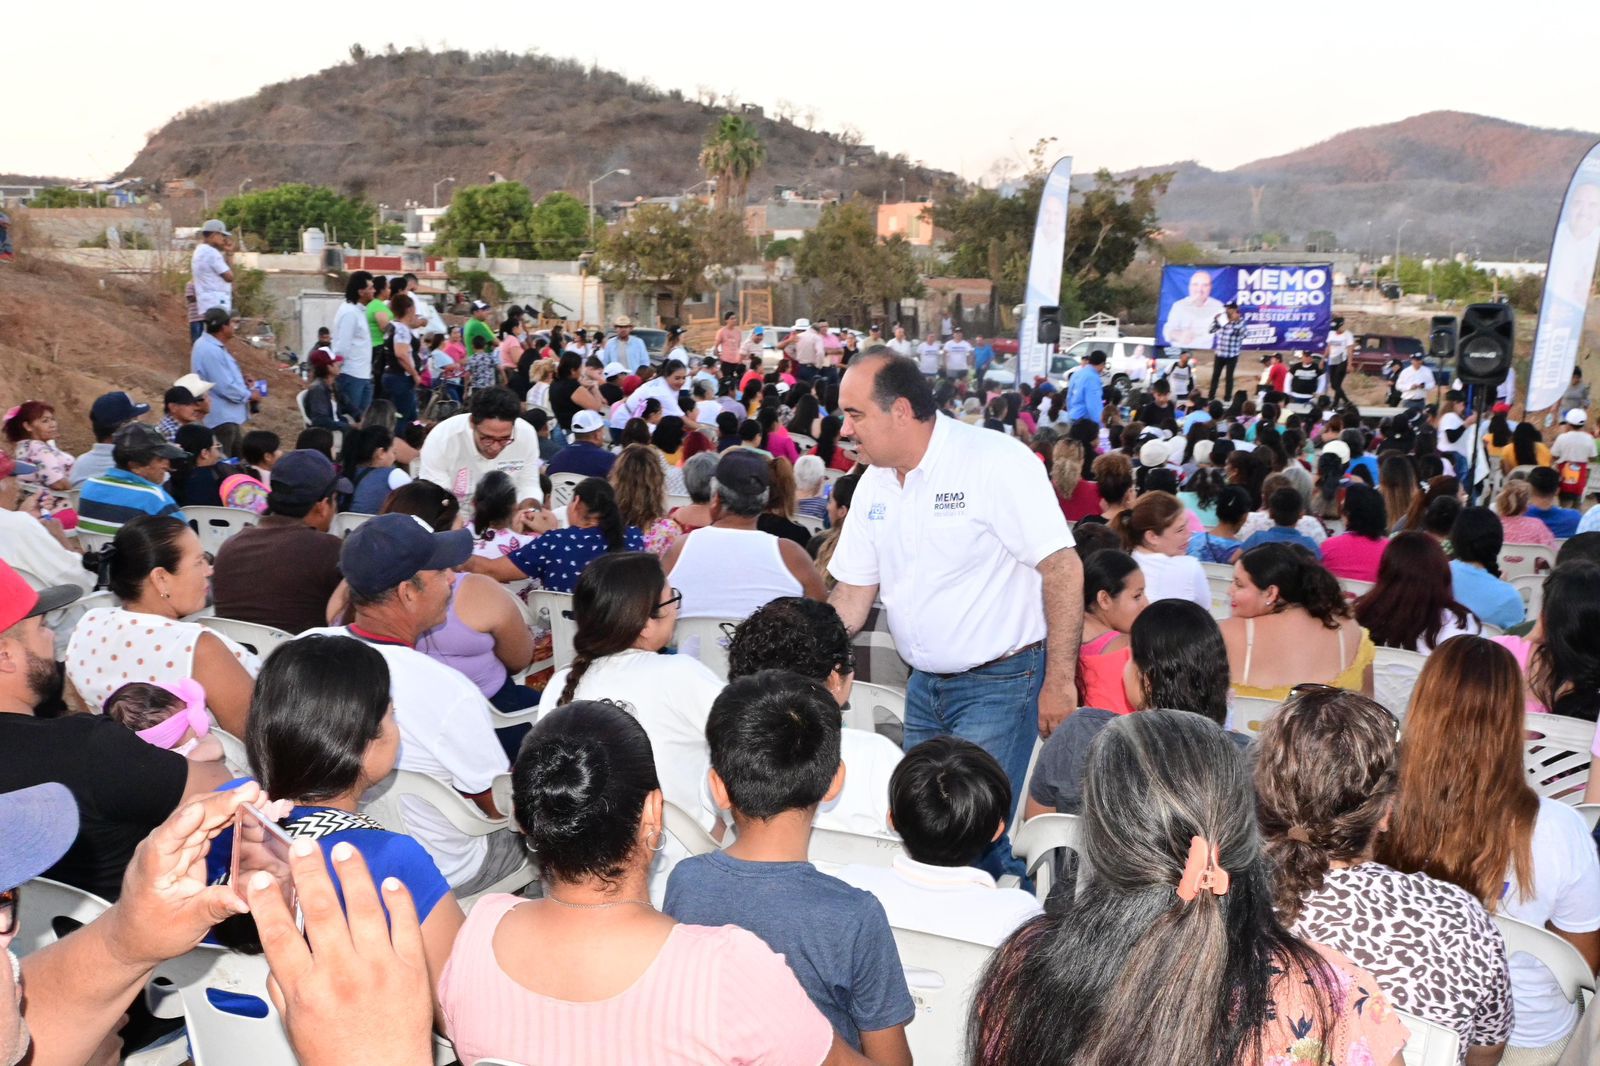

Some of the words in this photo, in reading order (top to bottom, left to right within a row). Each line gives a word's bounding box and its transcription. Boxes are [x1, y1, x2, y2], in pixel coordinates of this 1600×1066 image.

[1237, 268, 1326, 290] MEMO
[1237, 290, 1325, 306] ROMERO
[1244, 312, 1316, 322] PRESIDENTE
[935, 491, 965, 503] MEMO
